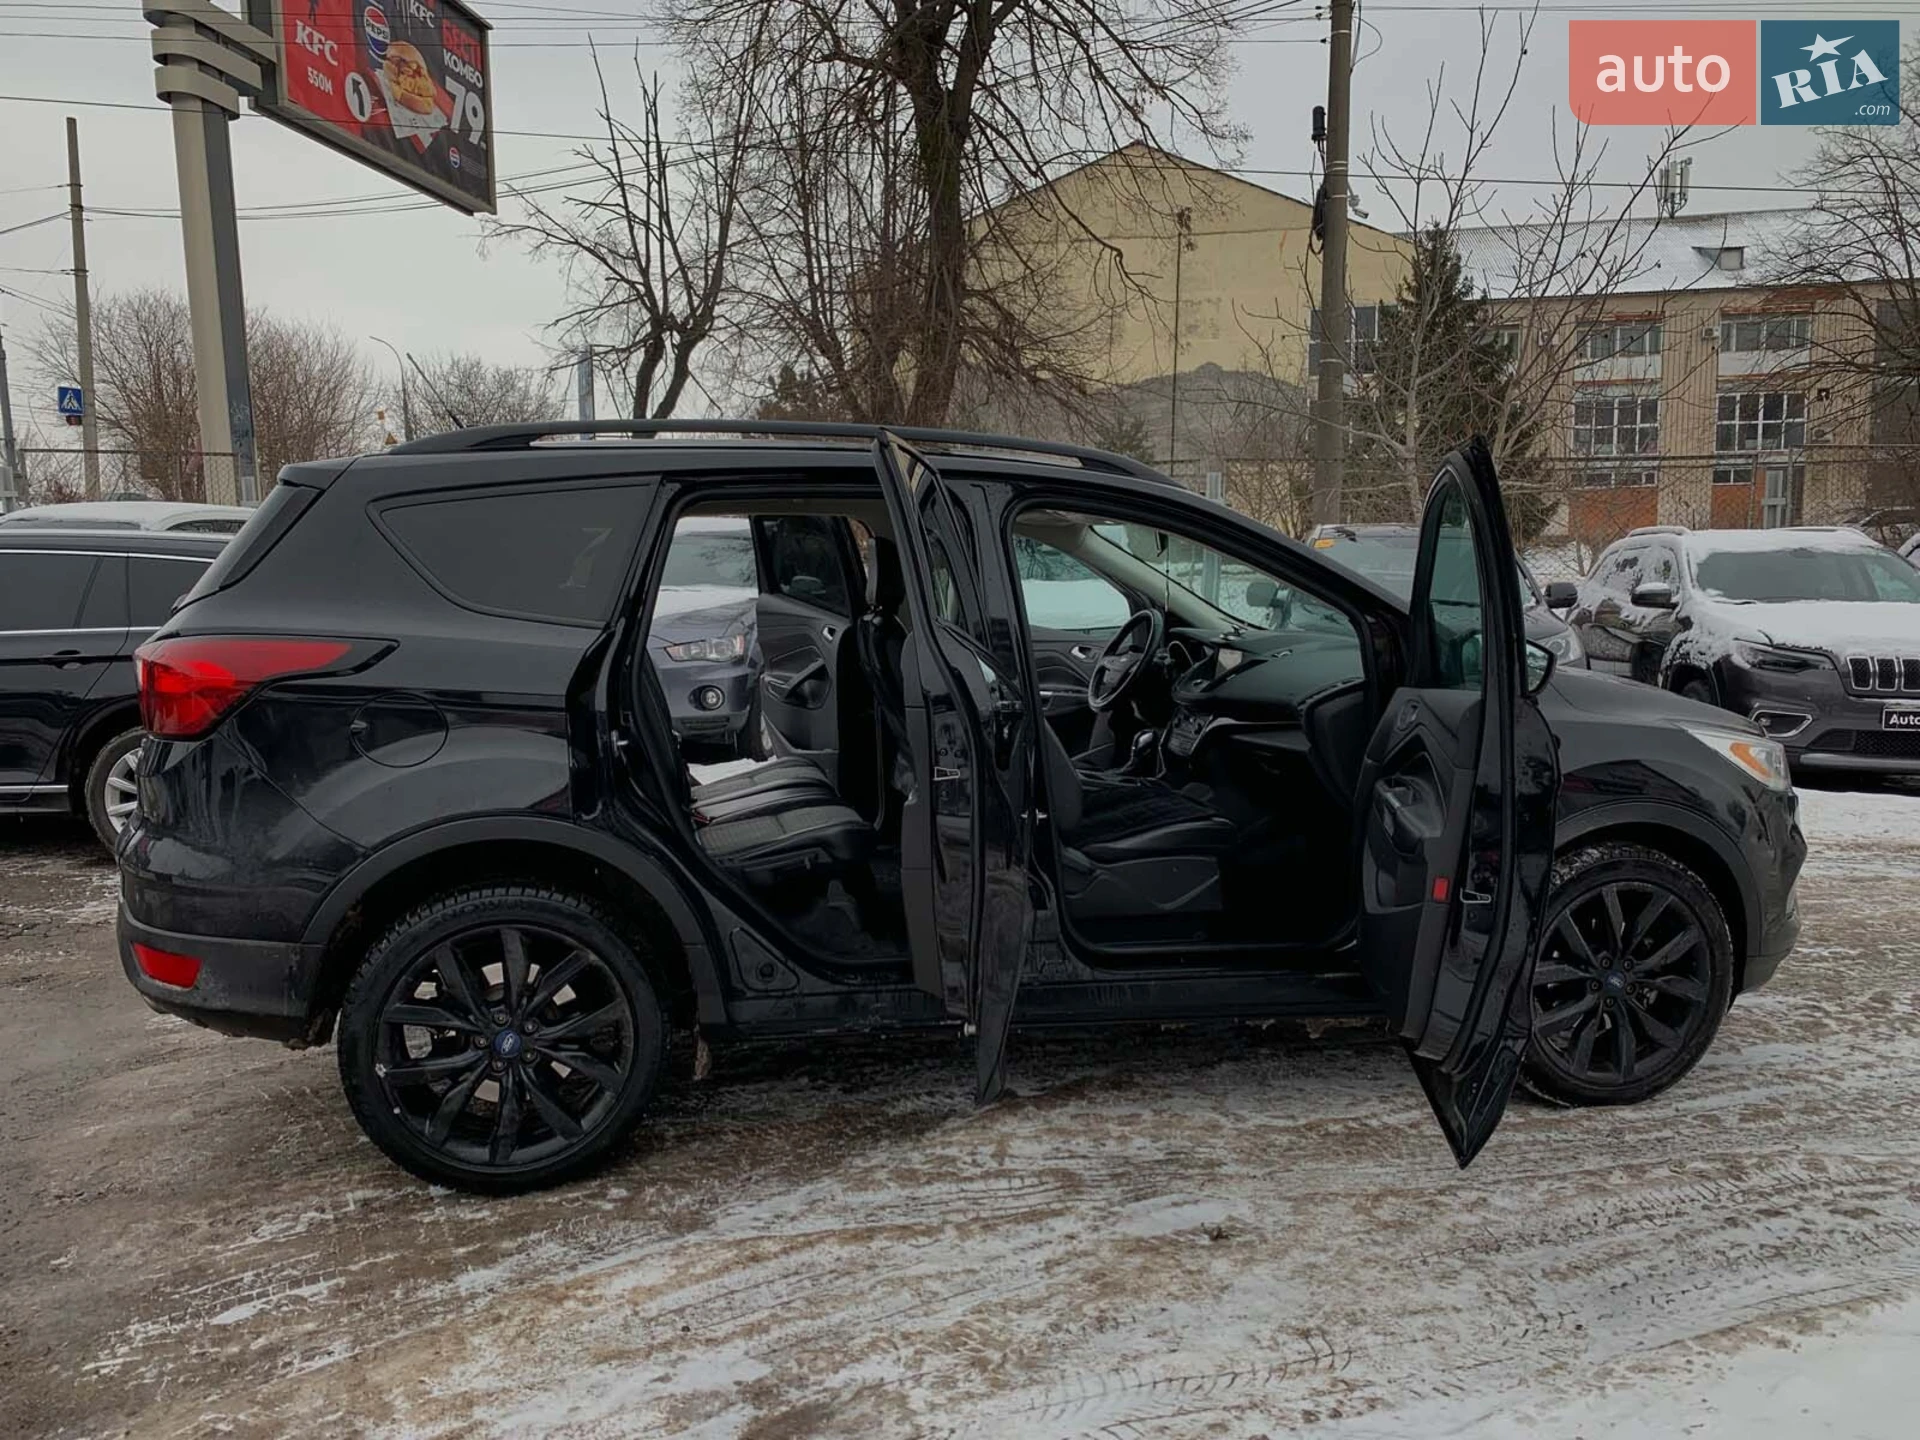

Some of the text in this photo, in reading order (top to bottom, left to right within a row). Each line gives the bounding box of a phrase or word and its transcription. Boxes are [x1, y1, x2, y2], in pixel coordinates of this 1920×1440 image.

[409, 0, 435, 28] KFC
[295, 19, 338, 67] KFC
[443, 48, 483, 88] КОМБО
